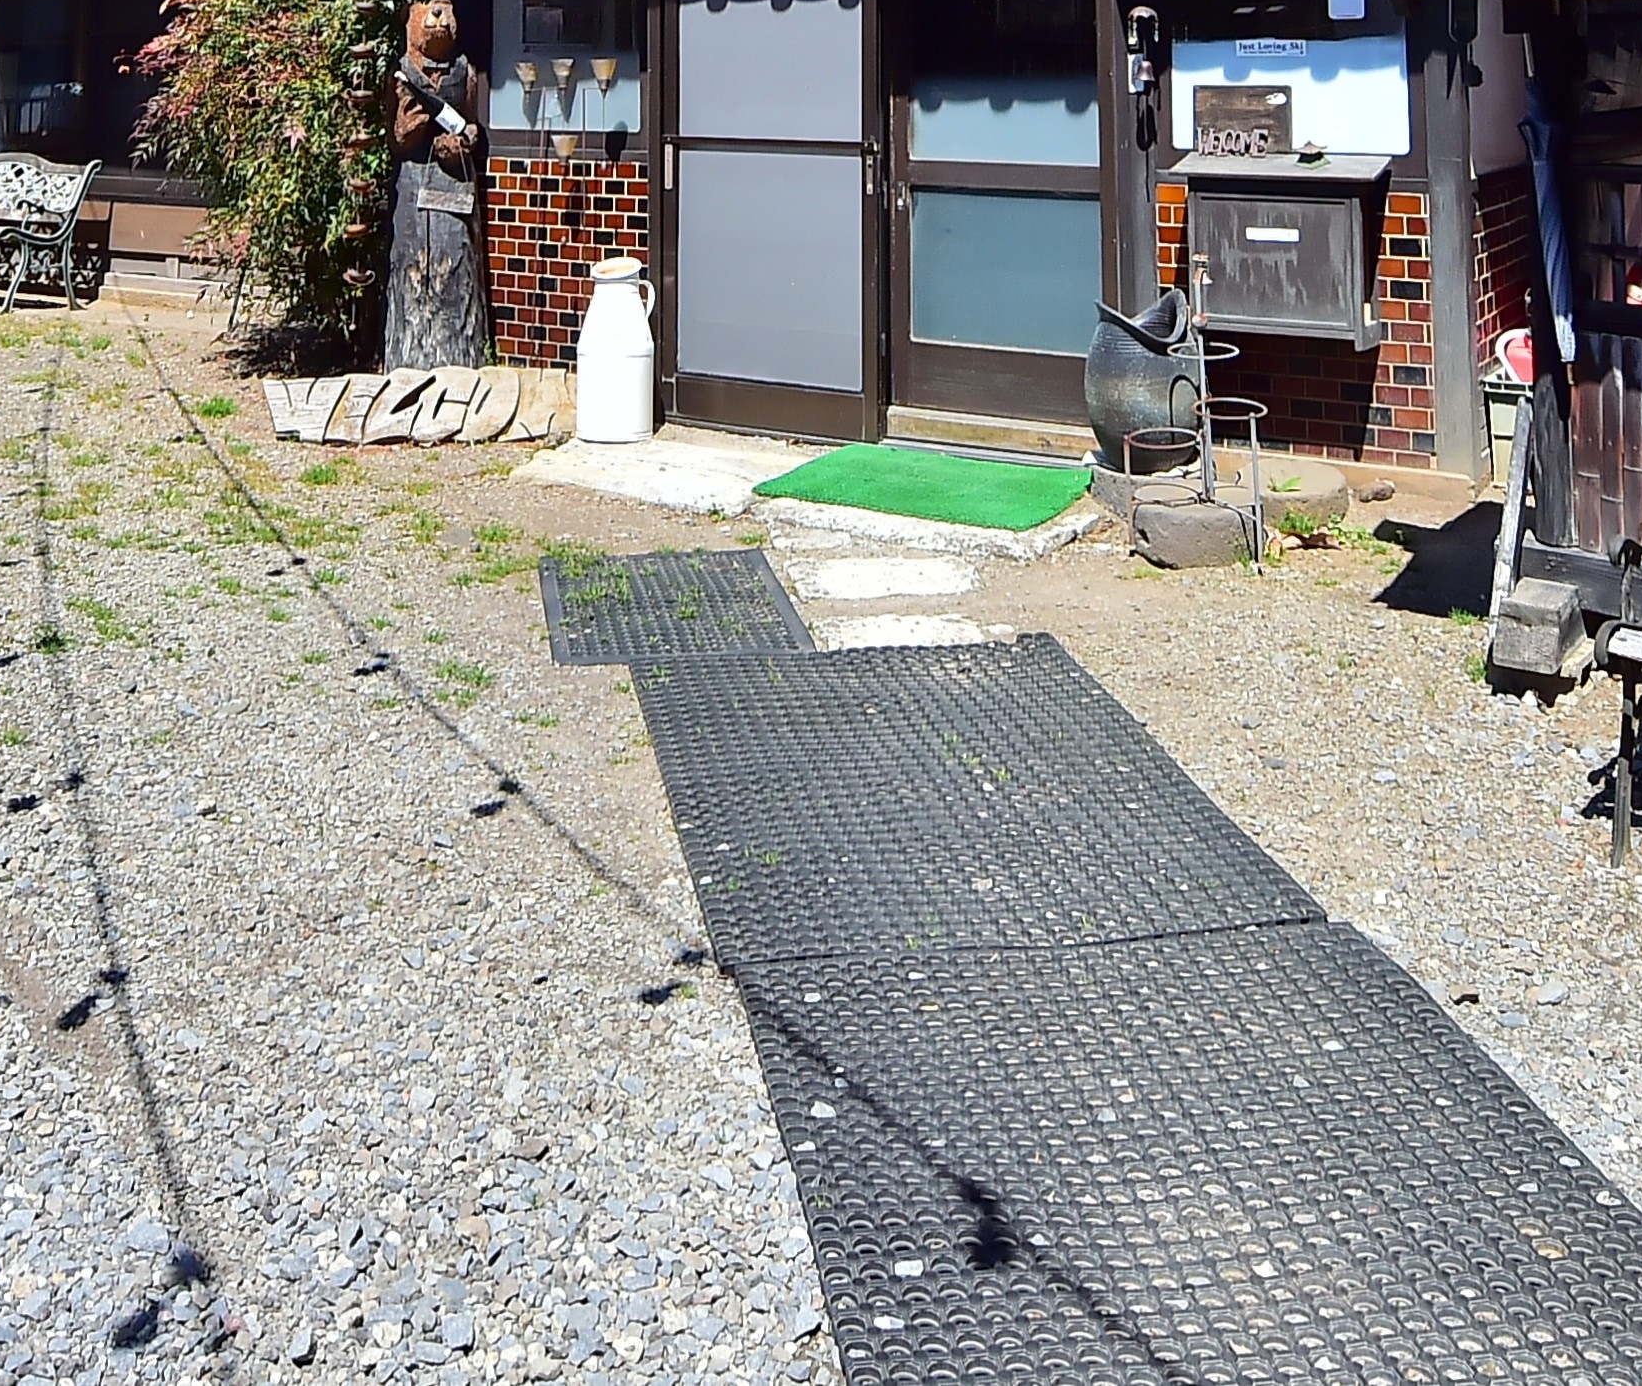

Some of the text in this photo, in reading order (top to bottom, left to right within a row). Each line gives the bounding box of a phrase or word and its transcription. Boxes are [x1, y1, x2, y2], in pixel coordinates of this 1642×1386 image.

[1239, 42, 1255, 52] Just
[1258, 41, 1287, 51] Loving
[1197, 126, 1269, 158] WELCOME
[262, 365, 576, 447] WELCOM
